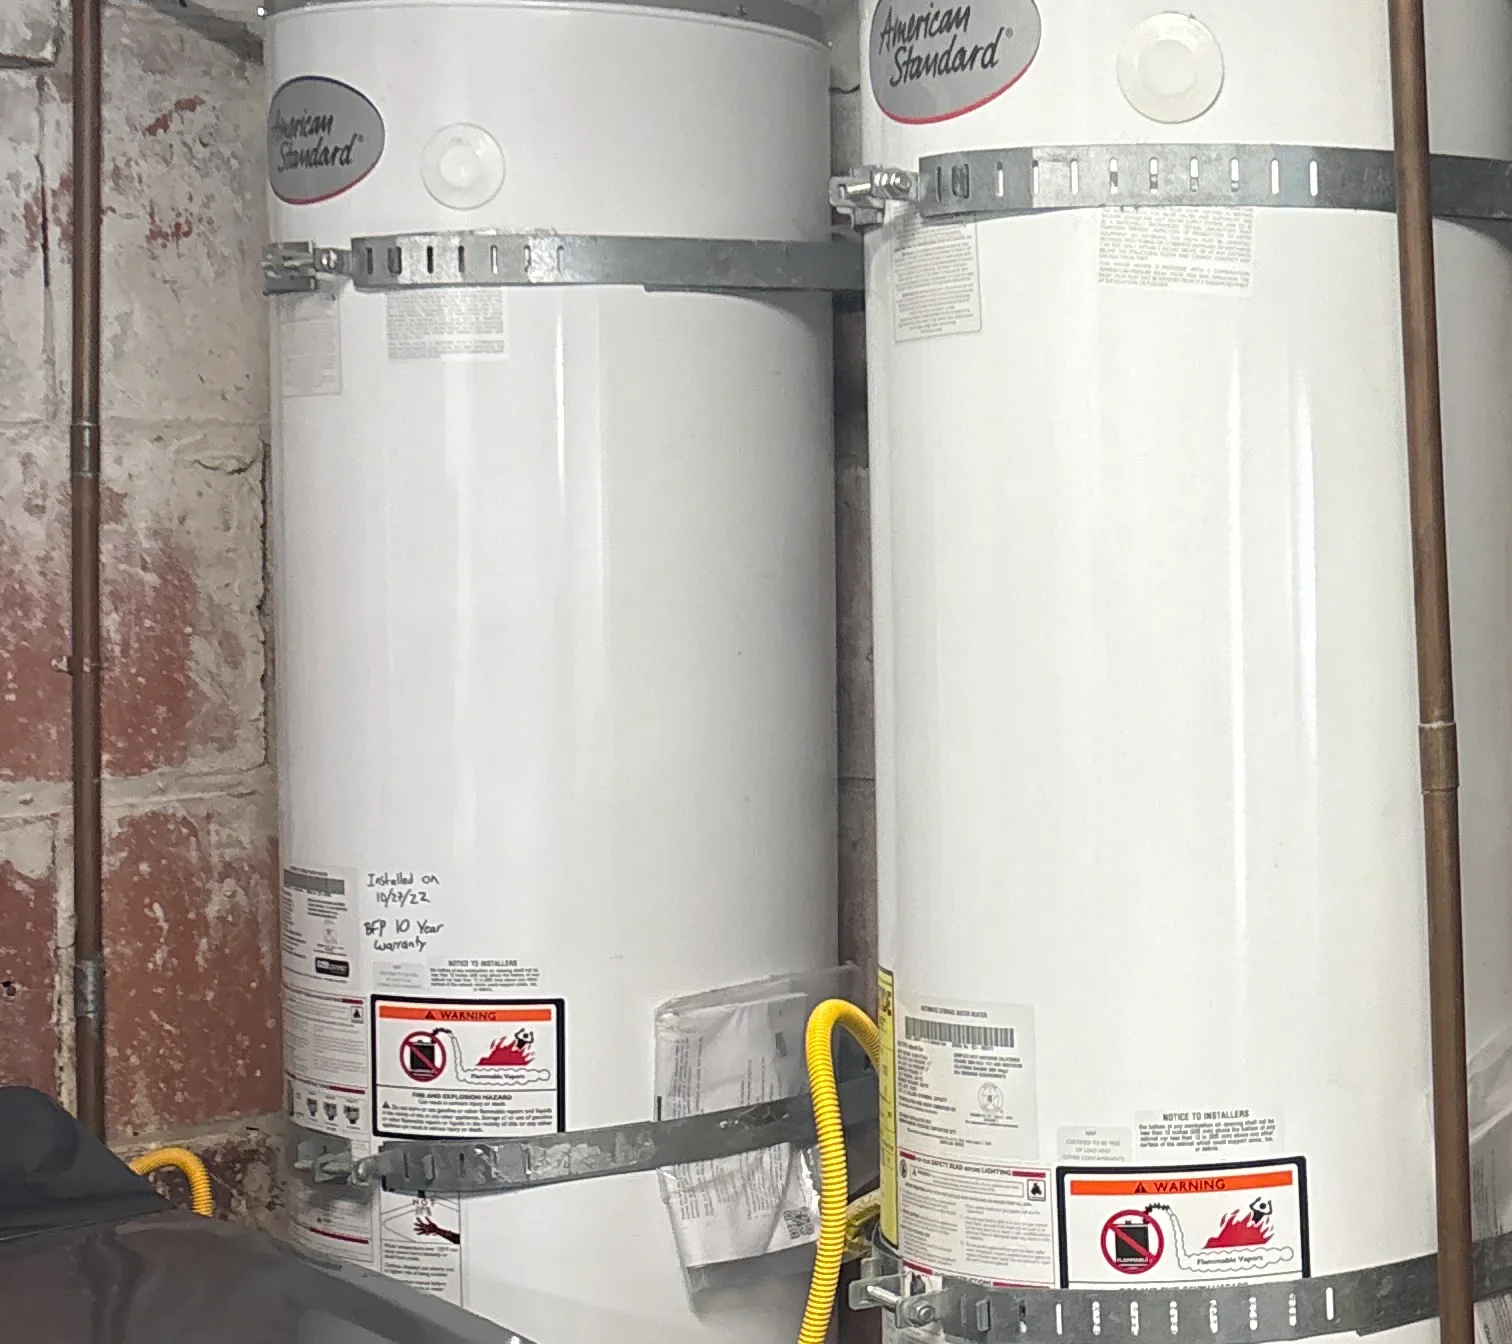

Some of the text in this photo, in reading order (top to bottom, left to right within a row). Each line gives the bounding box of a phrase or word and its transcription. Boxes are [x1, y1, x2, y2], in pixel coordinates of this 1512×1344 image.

[879, 2, 970, 55] American
[889, 26, 1005, 87] Standard
[367, 872, 440, 887] Installed on
[396, 919, 410, 934] 10
[440, 1011, 497, 1021] WARNING
[1163, 1109, 1249, 1121] NOTICE TO INSTALLERS
[1154, 1178, 1226, 1192] WARNING
[1197, 1254, 1263, 1265] Flammable Vapors
